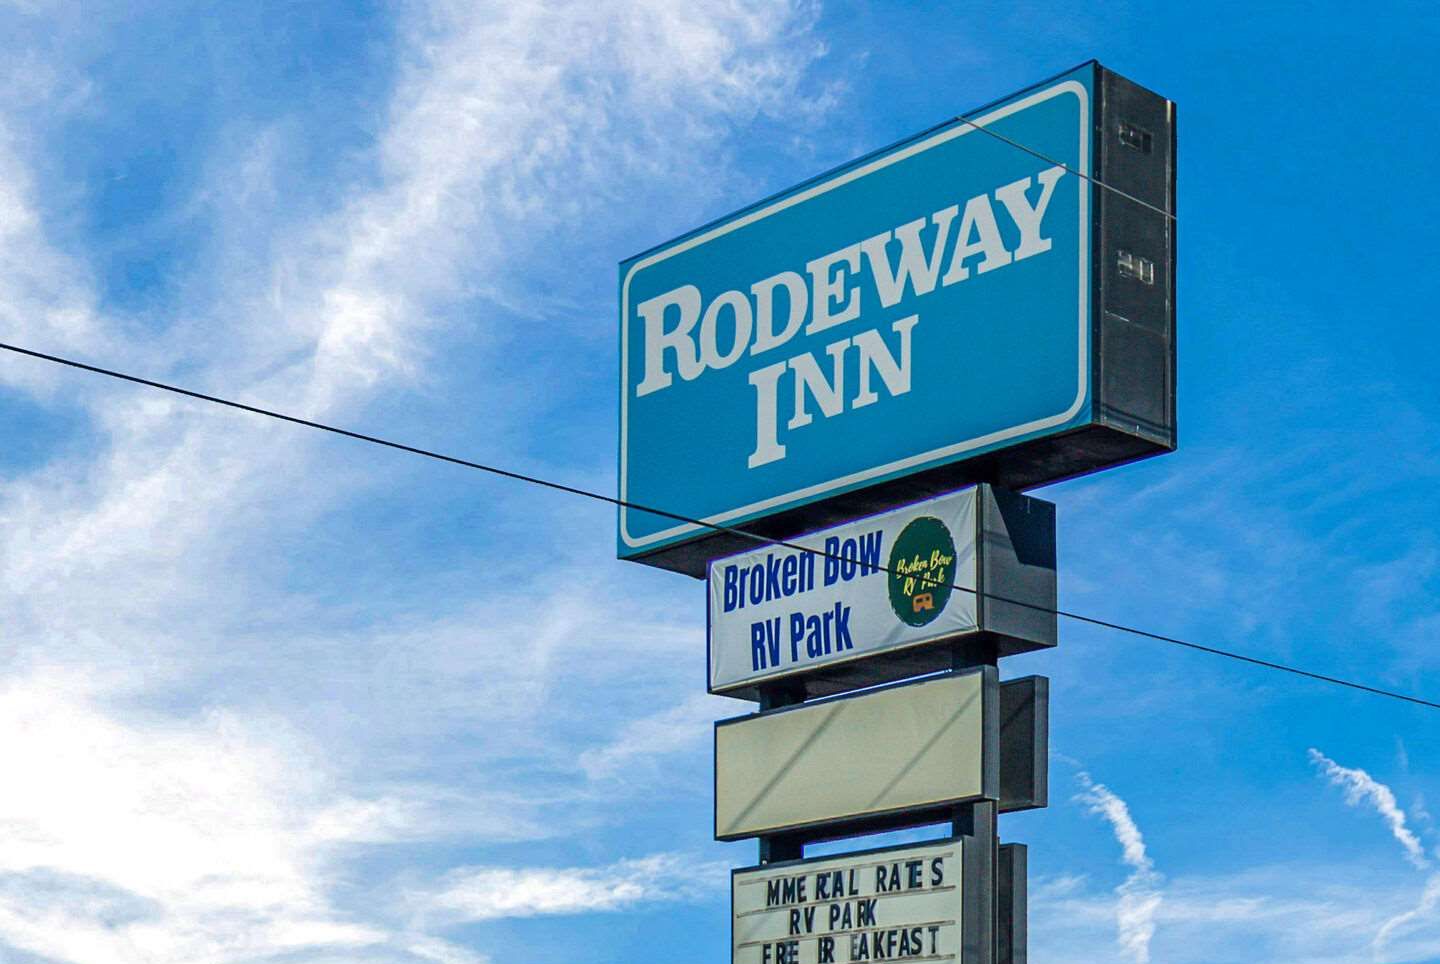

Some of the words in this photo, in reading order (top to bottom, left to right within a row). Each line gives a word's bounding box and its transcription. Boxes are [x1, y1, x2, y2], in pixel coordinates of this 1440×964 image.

[636, 163, 1067, 398] RODEWAY
[747, 314, 919, 469] INN
[723, 551, 815, 613] Broken
[824, 530, 883, 587] Bow
[896, 554, 928, 580] Broken
[929, 549, 953, 571] Bow
[750, 618, 781, 672] RV
[790, 601, 854, 662] Park
[789, 907, 816, 936] RV
[829, 899, 878, 931] PARK
